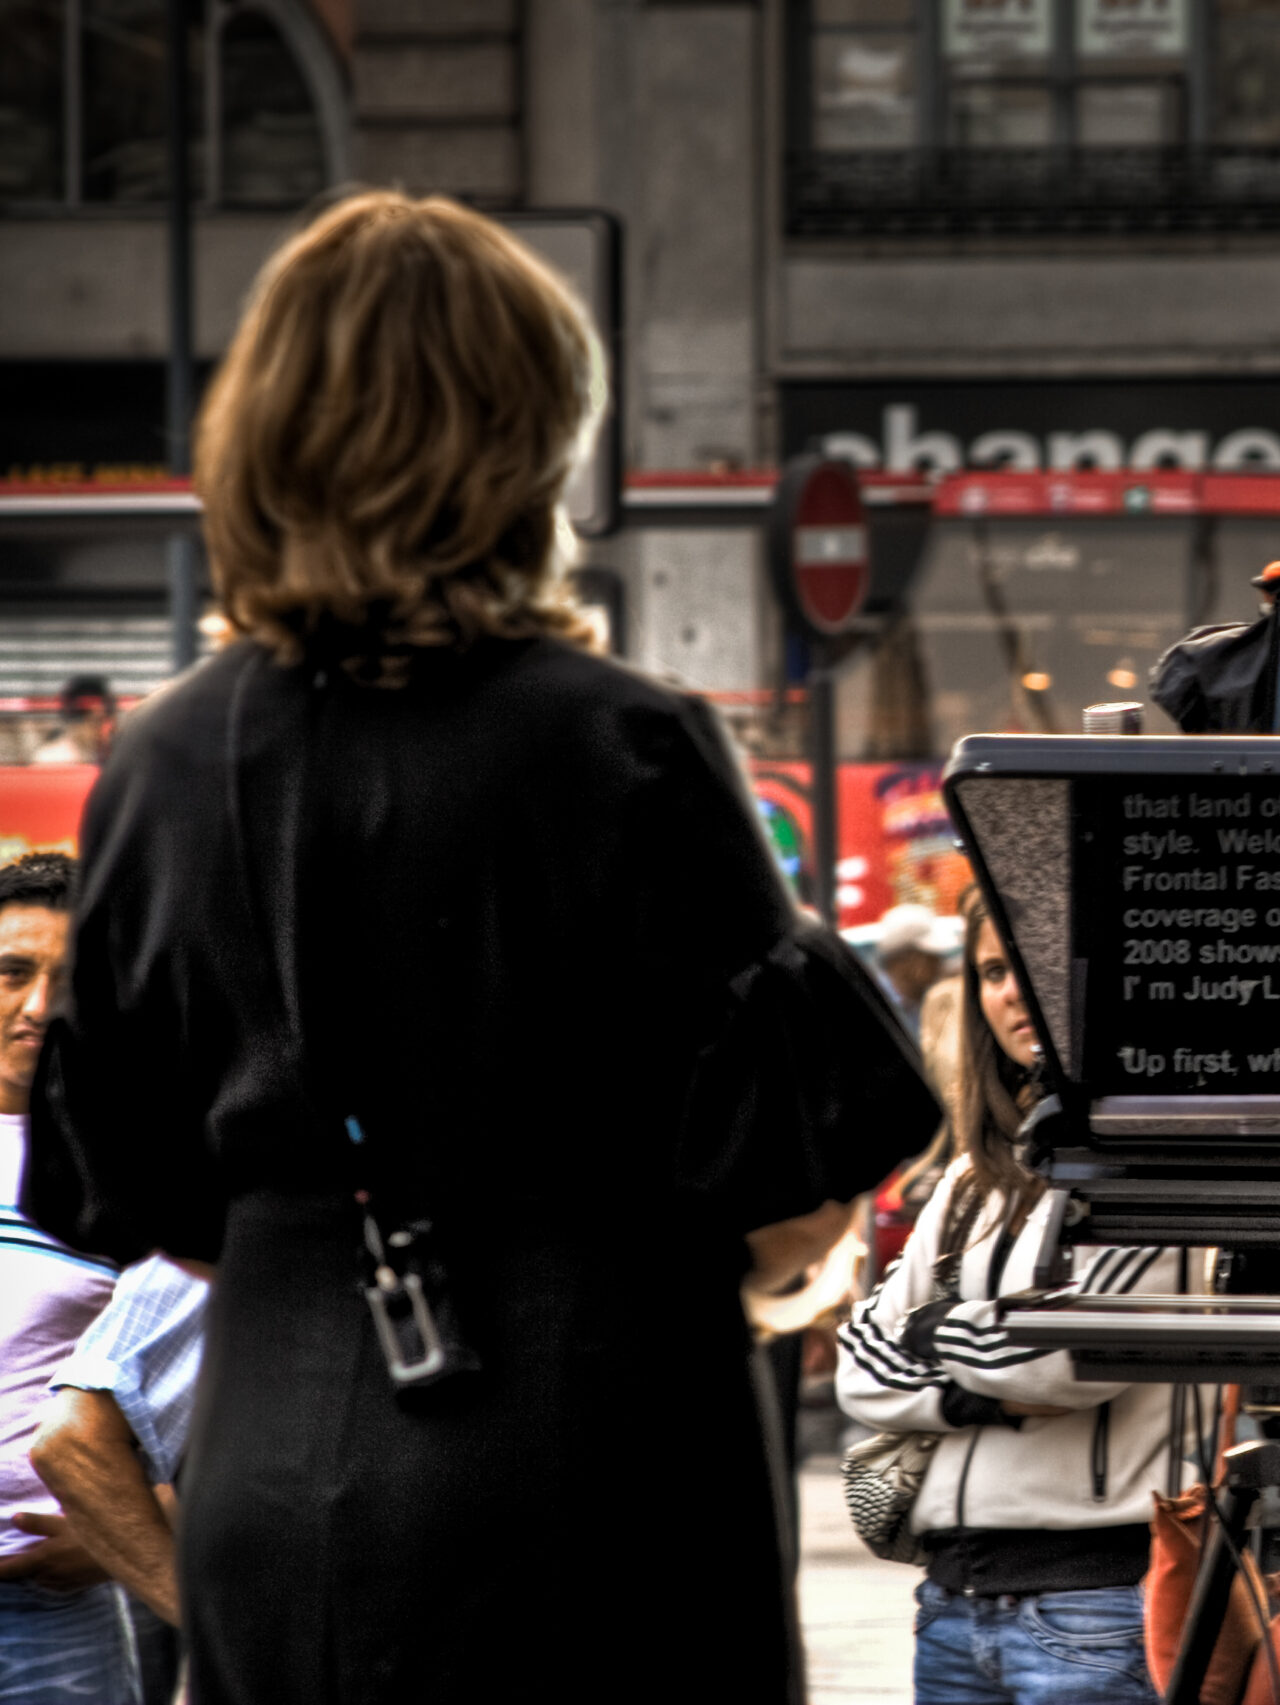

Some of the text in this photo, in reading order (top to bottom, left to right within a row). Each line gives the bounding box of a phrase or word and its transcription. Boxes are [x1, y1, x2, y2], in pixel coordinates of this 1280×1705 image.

[1122, 793, 1181, 819] that
[1188, 793, 1251, 818] land
[1122, 829, 1200, 861] style.
[1122, 865, 1228, 892] Frontal
[1122, 907, 1257, 934] coverage
[1122, 938, 1192, 965] 2008
[1122, 975, 1176, 1001] I'm
[1182, 974, 1254, 1007] Judy
[1121, 1046, 1166, 1078] Up
